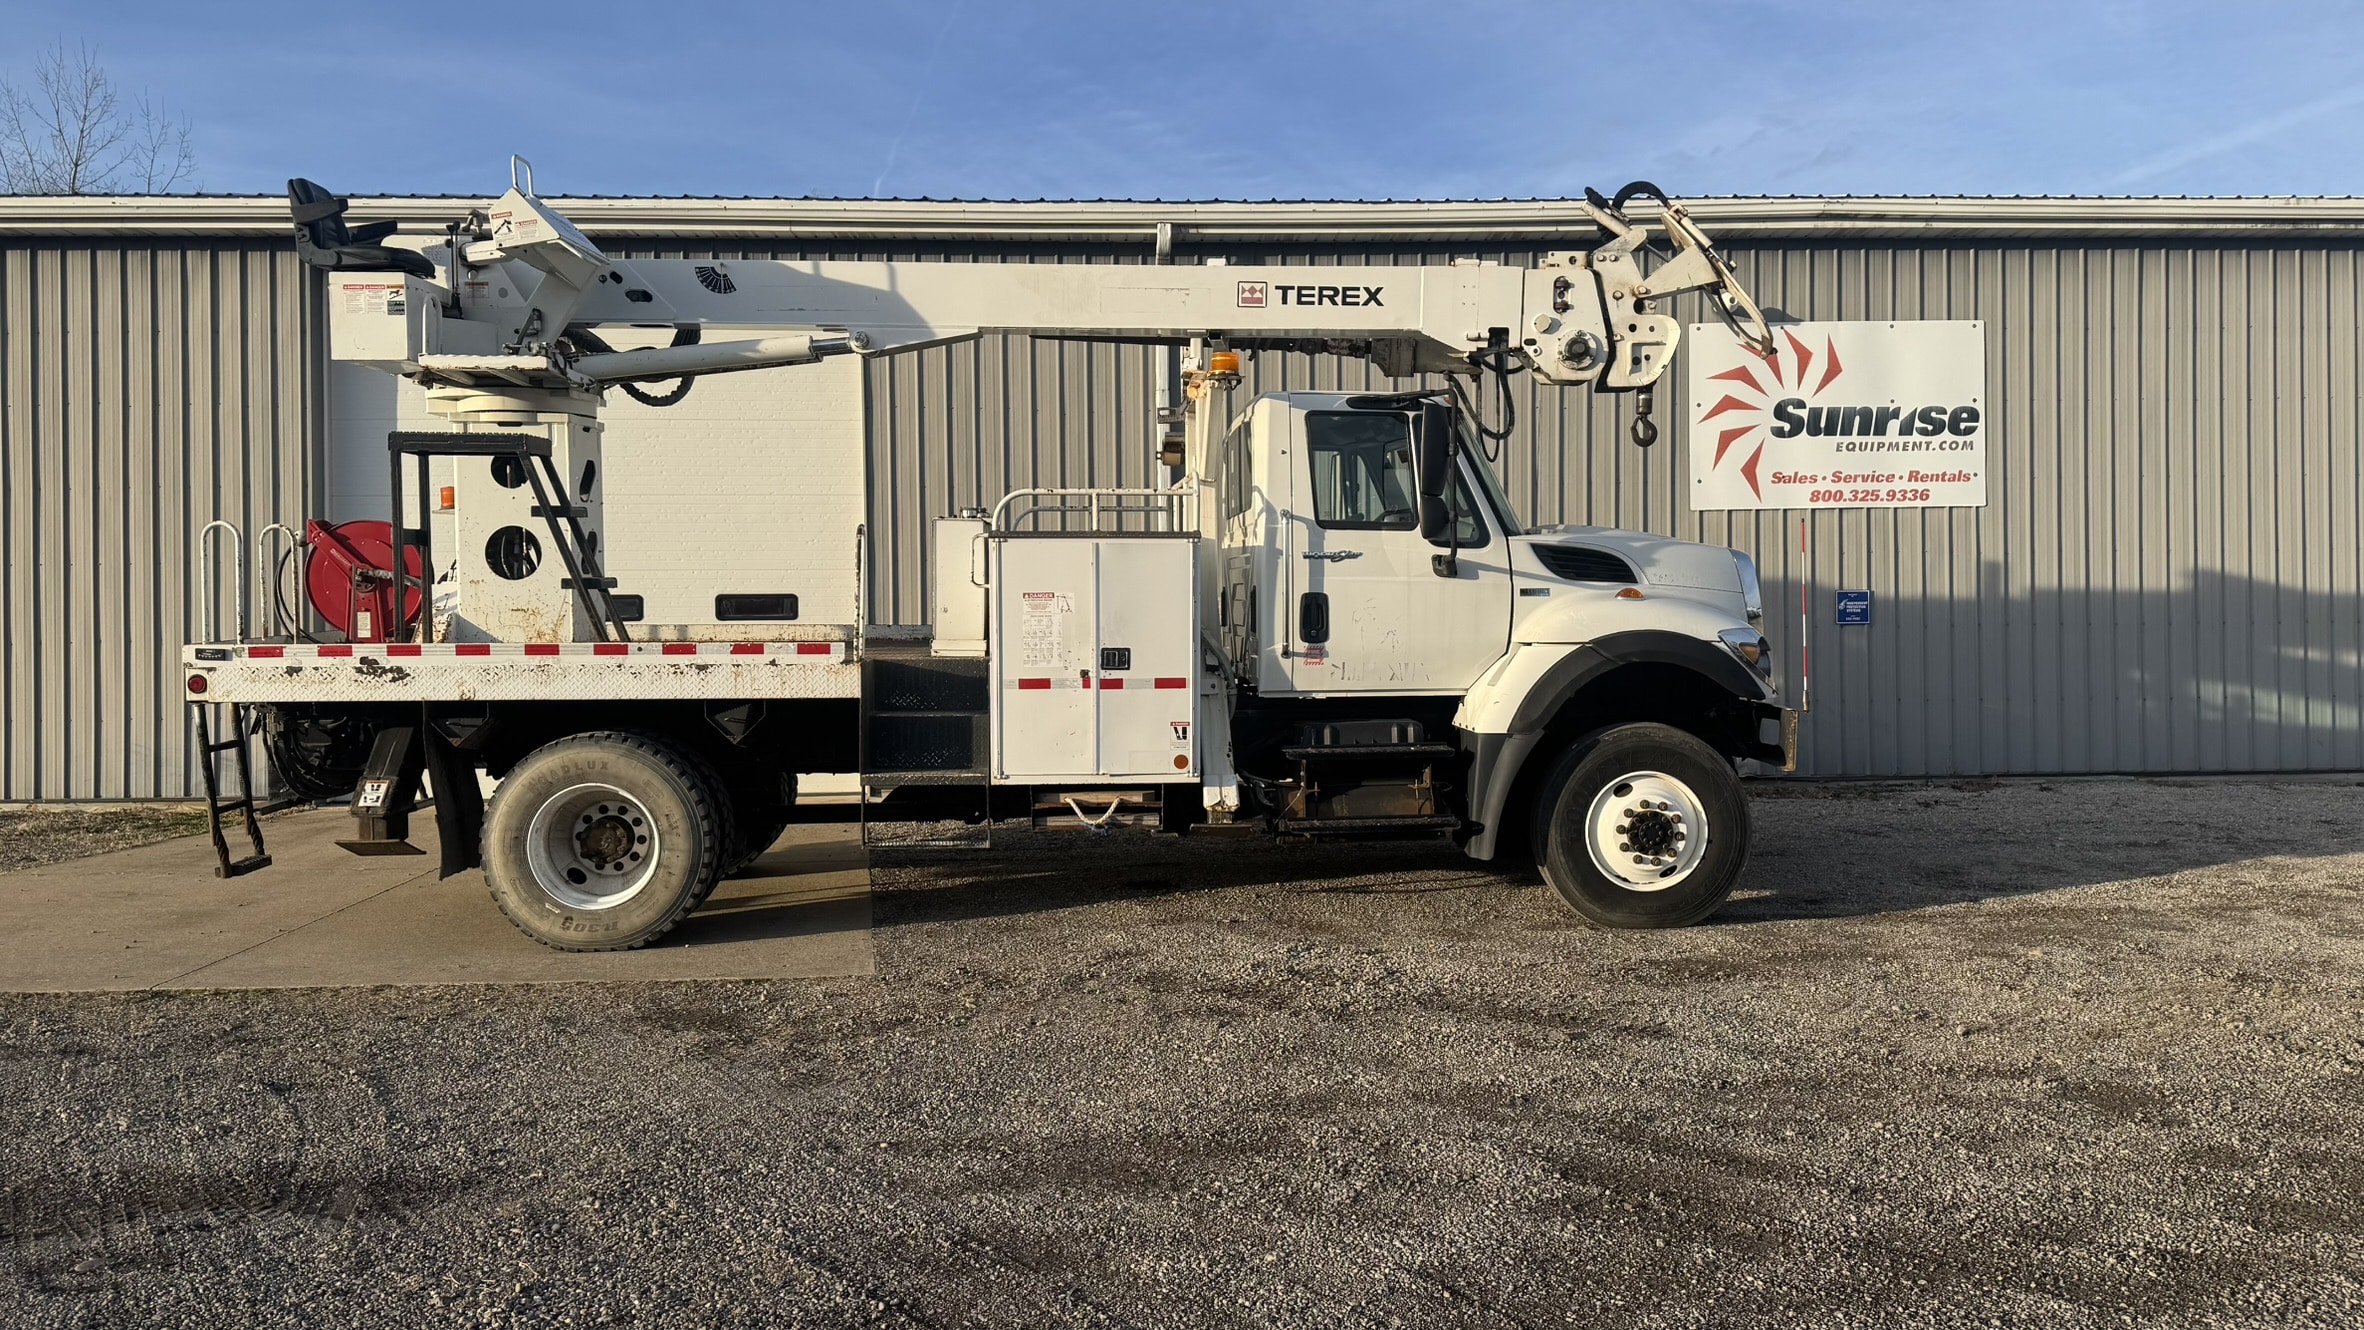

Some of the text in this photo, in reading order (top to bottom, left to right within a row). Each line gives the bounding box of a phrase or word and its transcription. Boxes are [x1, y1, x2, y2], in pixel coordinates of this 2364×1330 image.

[1275, 285, 1384, 307] TEREX
[1770, 397, 1980, 439] Sunrise
[1835, 440, 1974, 453] EQUIPMENT.COM
[1771, 470, 1971, 484] Sales Service Rentals
[1809, 488, 1930, 502] 800.325.9336
